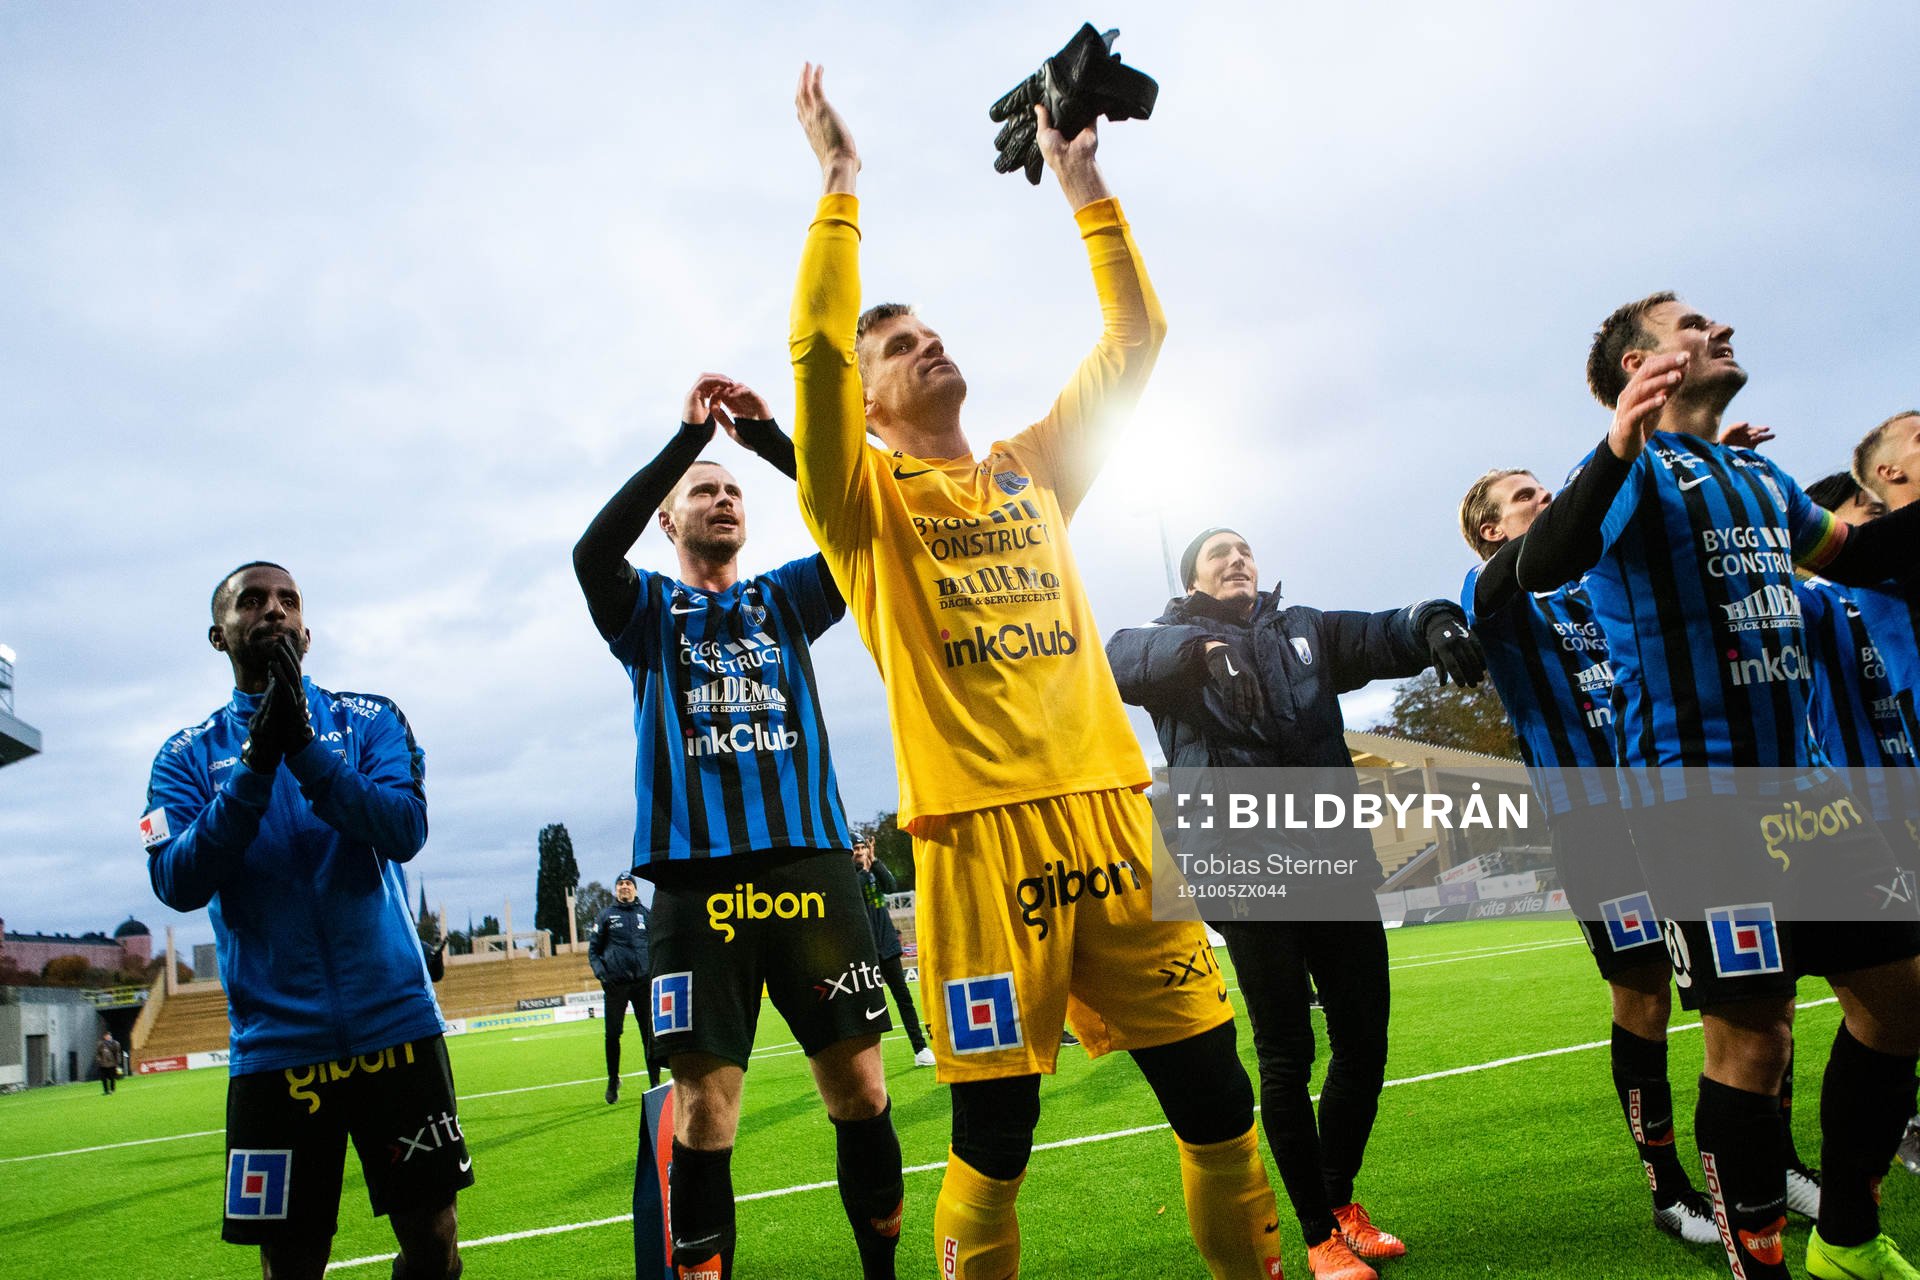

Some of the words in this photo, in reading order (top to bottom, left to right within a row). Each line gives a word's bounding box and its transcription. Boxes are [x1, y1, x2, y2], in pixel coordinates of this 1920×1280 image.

[926, 524, 1050, 560] ONSTRUCT
[1702, 526, 1759, 552] BYGG
[933, 566, 1060, 596] BILDEMO
[1707, 552, 1795, 577] CONSTRU
[1720, 584, 1802, 621] BILDEM
[941, 620, 1077, 668] inkClub
[1553, 622, 1597, 637] BYGG
[1562, 637, 1610, 651] CONST
[680, 647, 781, 674] CONSTRUCT
[1727, 645, 1812, 686] inkClu
[683, 676, 787, 704] BILDEMO
[720, 703, 787, 713] SERVICECENTER
[685, 723, 799, 757] inkClub
[1760, 797, 1862, 872] gibon
[706, 883, 826, 943] gibon
[1016, 860, 1141, 942] gibon
[1477, 901, 1506, 918] xite
[1512, 896, 1545, 914] xite
[1171, 938, 1220, 986] xit
[824, 961, 886, 1000] xite
[1630, 1090, 1645, 1143] OTOR
[1702, 1152, 1734, 1254] MOTOR
[1746, 1231, 1781, 1250] arem
